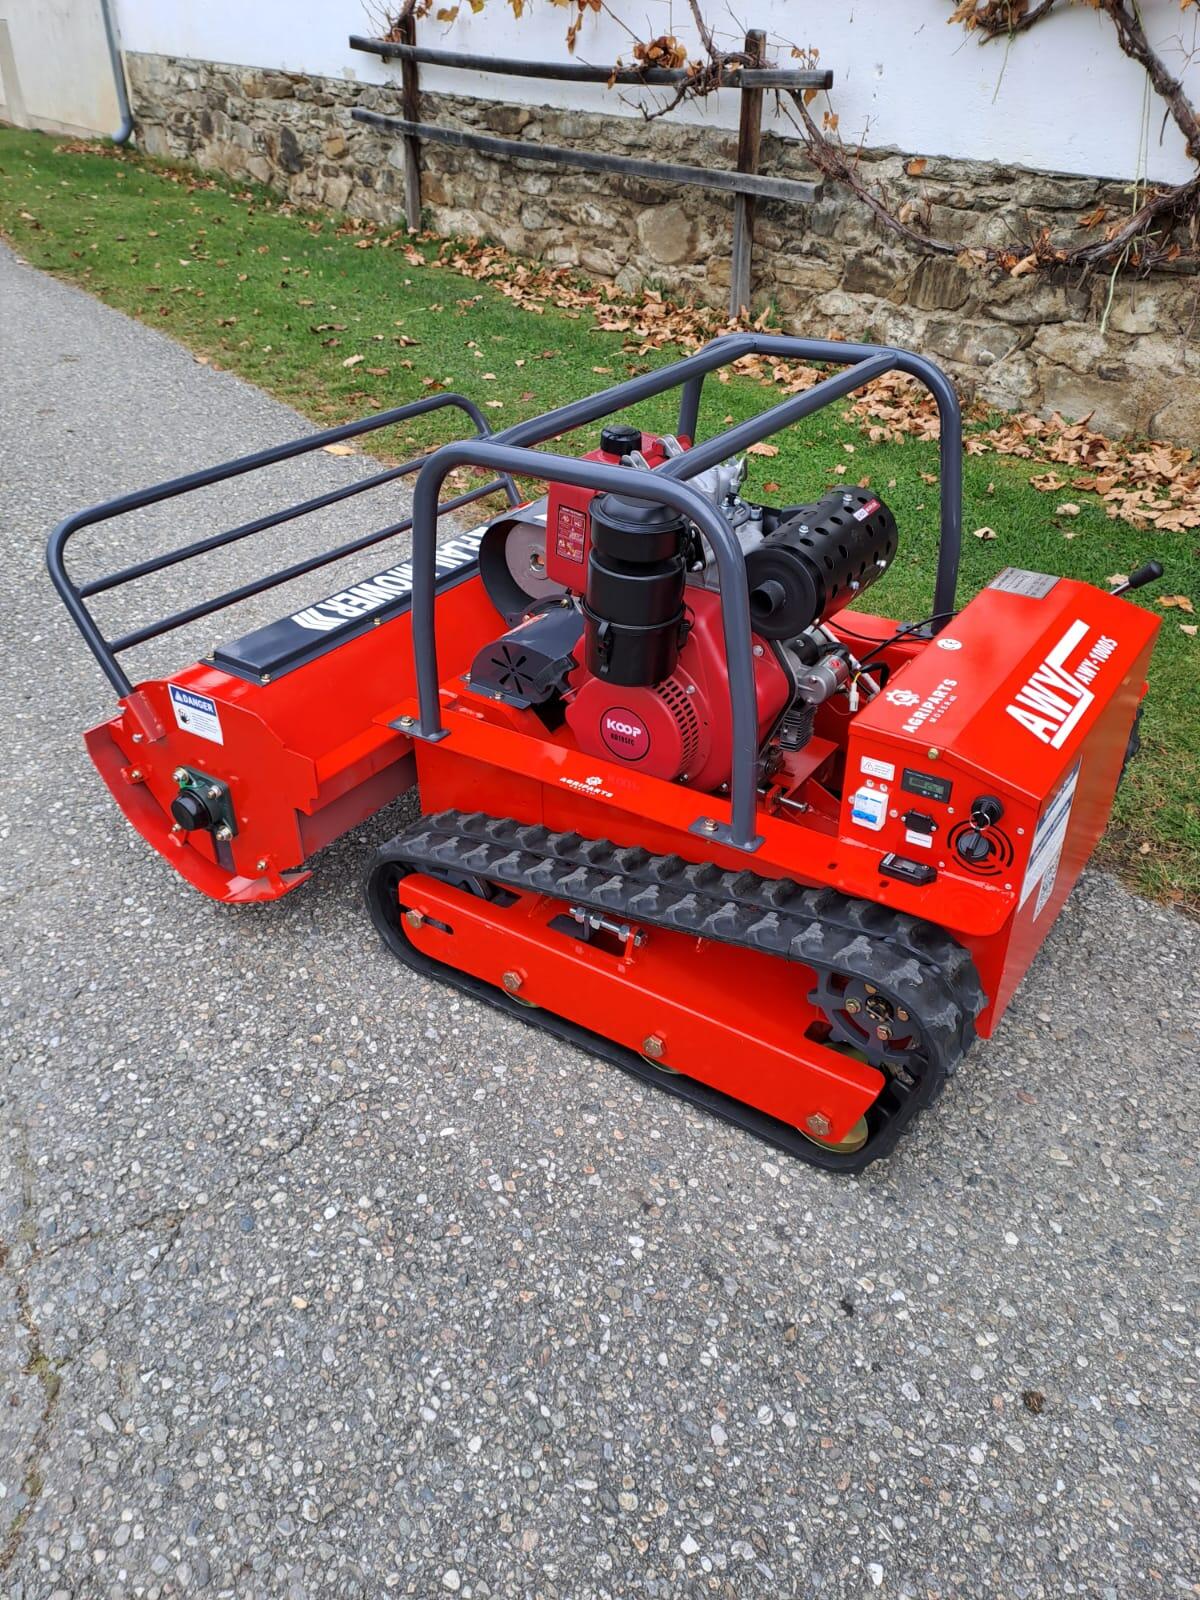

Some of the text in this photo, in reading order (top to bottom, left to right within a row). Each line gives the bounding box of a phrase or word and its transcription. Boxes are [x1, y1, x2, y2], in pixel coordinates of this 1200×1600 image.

[182, 693, 214, 713] DANGER
[901, 678, 958, 734] AGRIPARTS
[1005, 663, 1084, 744] AWY
[606, 718, 642, 737] KOOP
[559, 777, 614, 798] AGRIPARTS
